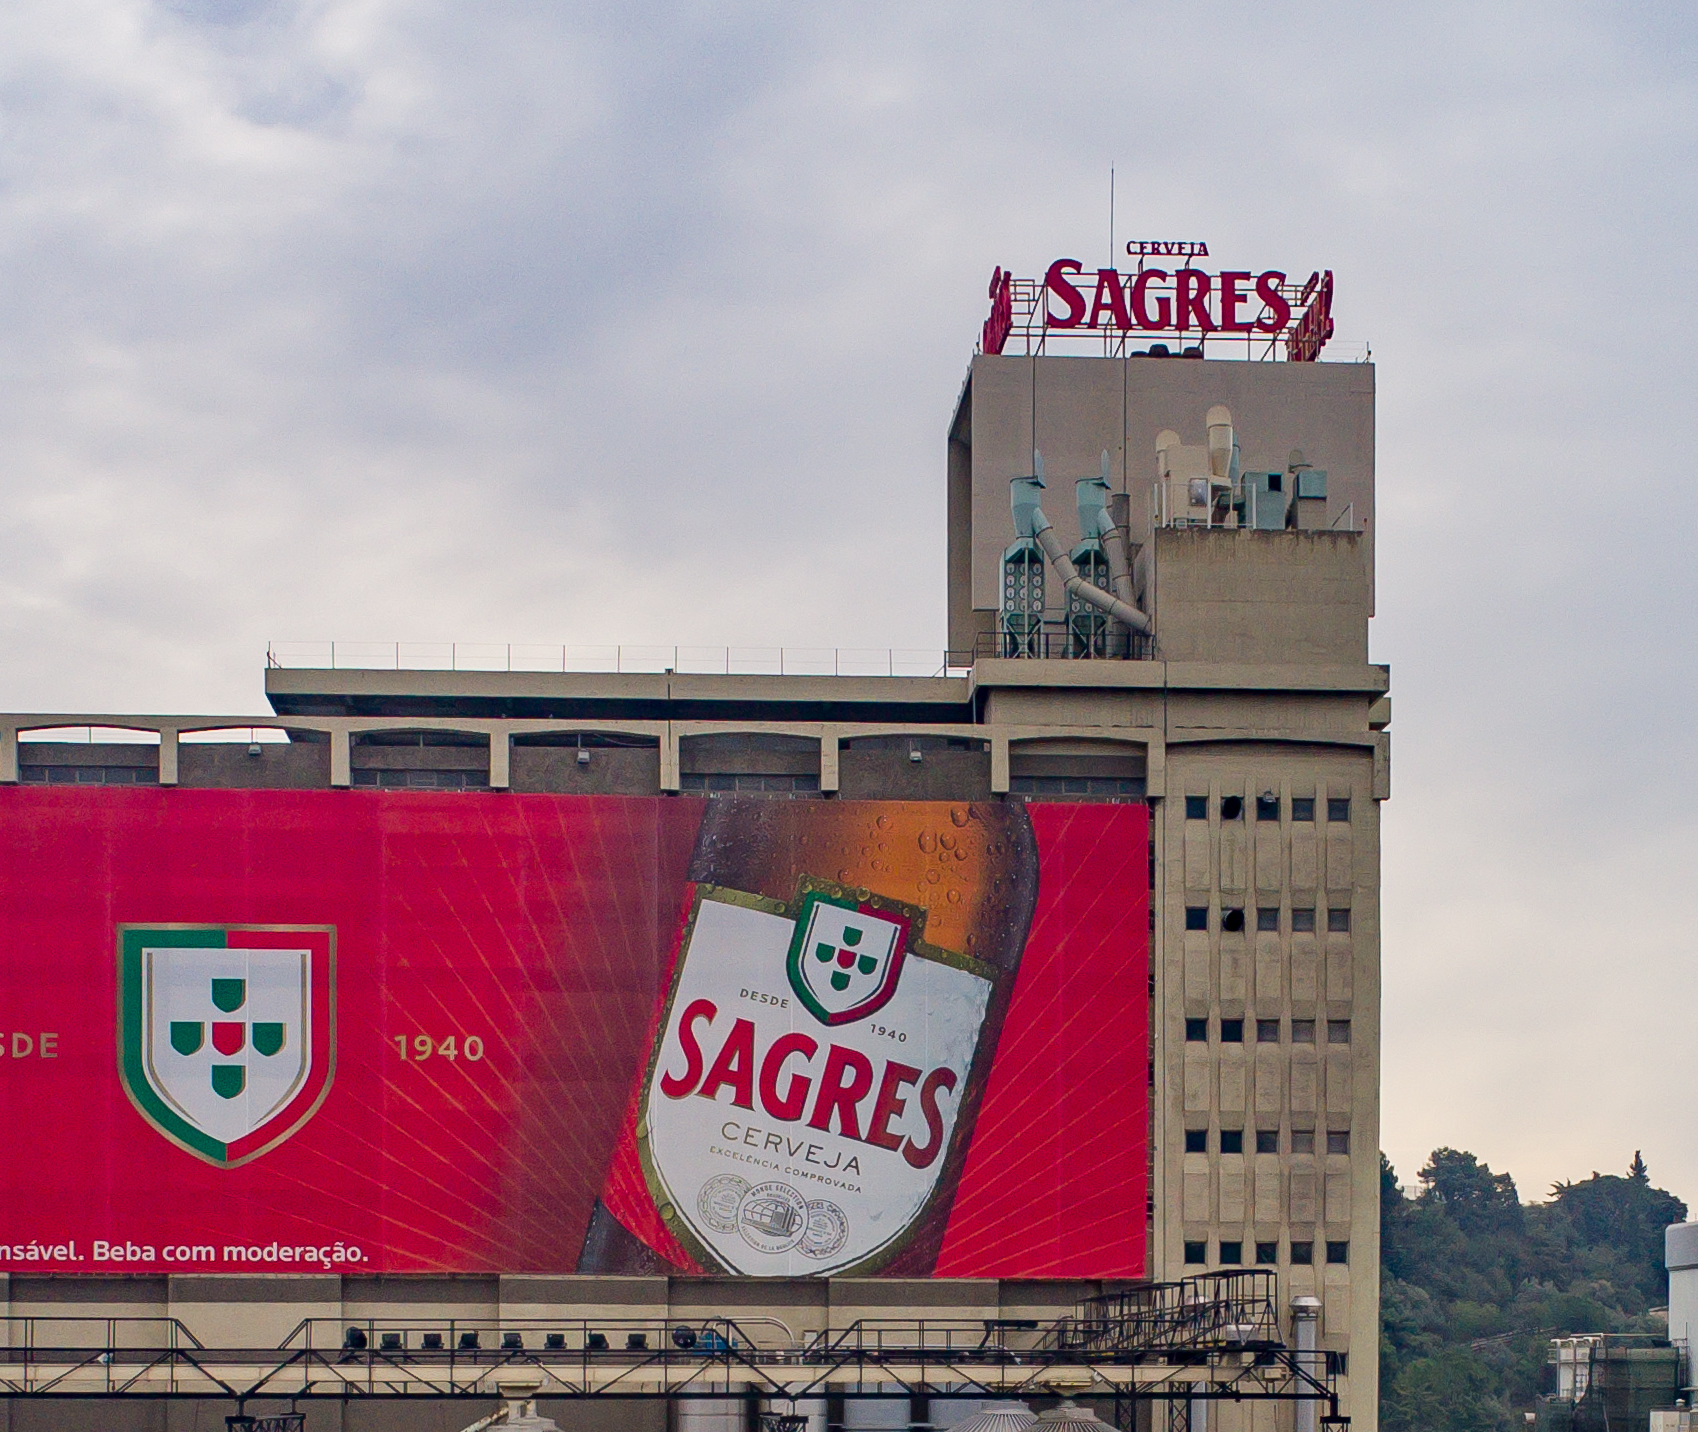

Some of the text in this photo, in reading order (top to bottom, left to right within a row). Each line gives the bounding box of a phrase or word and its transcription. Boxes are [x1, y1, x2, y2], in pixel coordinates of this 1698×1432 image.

[1045, 258, 1291, 333] SAGRES
[739, 988, 789, 1009] DESDE
[393, 1034, 484, 1062] 1940
[870, 1023, 907, 1043] 1940
[660, 998, 958, 1170] SAGRES
[720, 1121, 862, 1177] CERVEJA
[709, 1145, 862, 1194] EXCELÊNCIA COMPROVADA
[93, 1240, 156, 1262] Beba
[162, 1245, 216, 1263] com
[222, 1240, 370, 1270] moderação.
